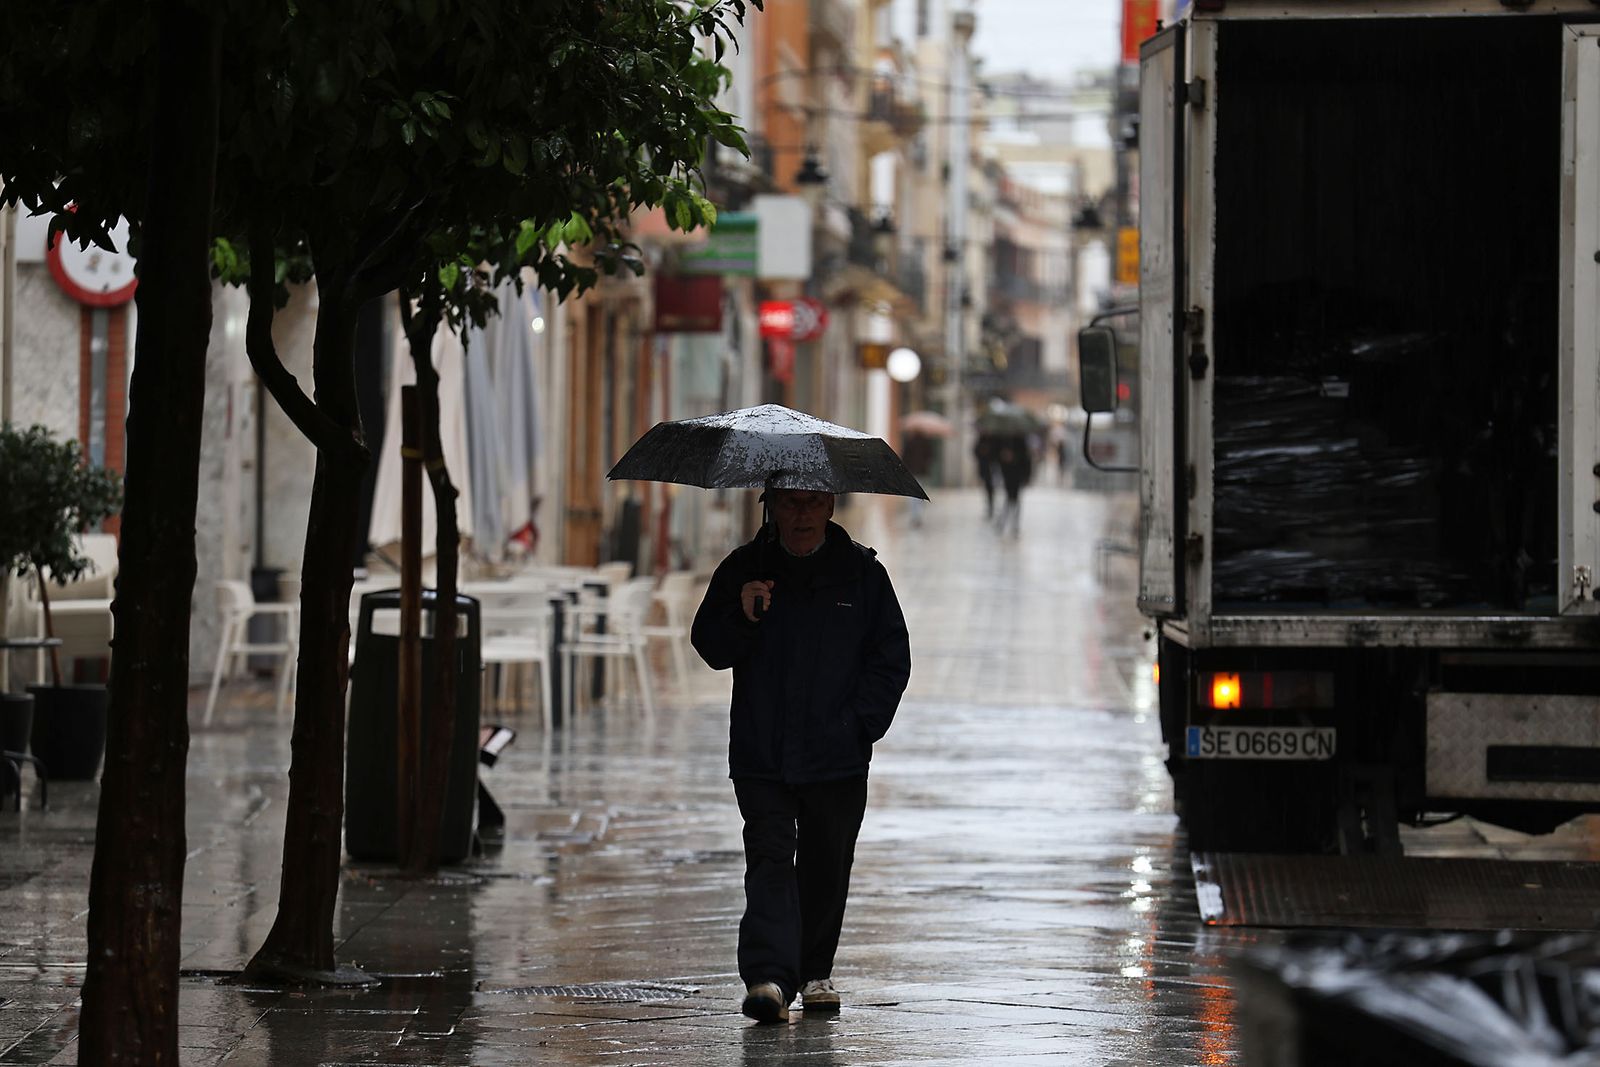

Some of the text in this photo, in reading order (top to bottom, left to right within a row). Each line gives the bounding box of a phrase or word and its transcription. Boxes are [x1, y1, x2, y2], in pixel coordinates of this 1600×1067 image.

[1202, 731, 1332, 756] SE 0669 CN
